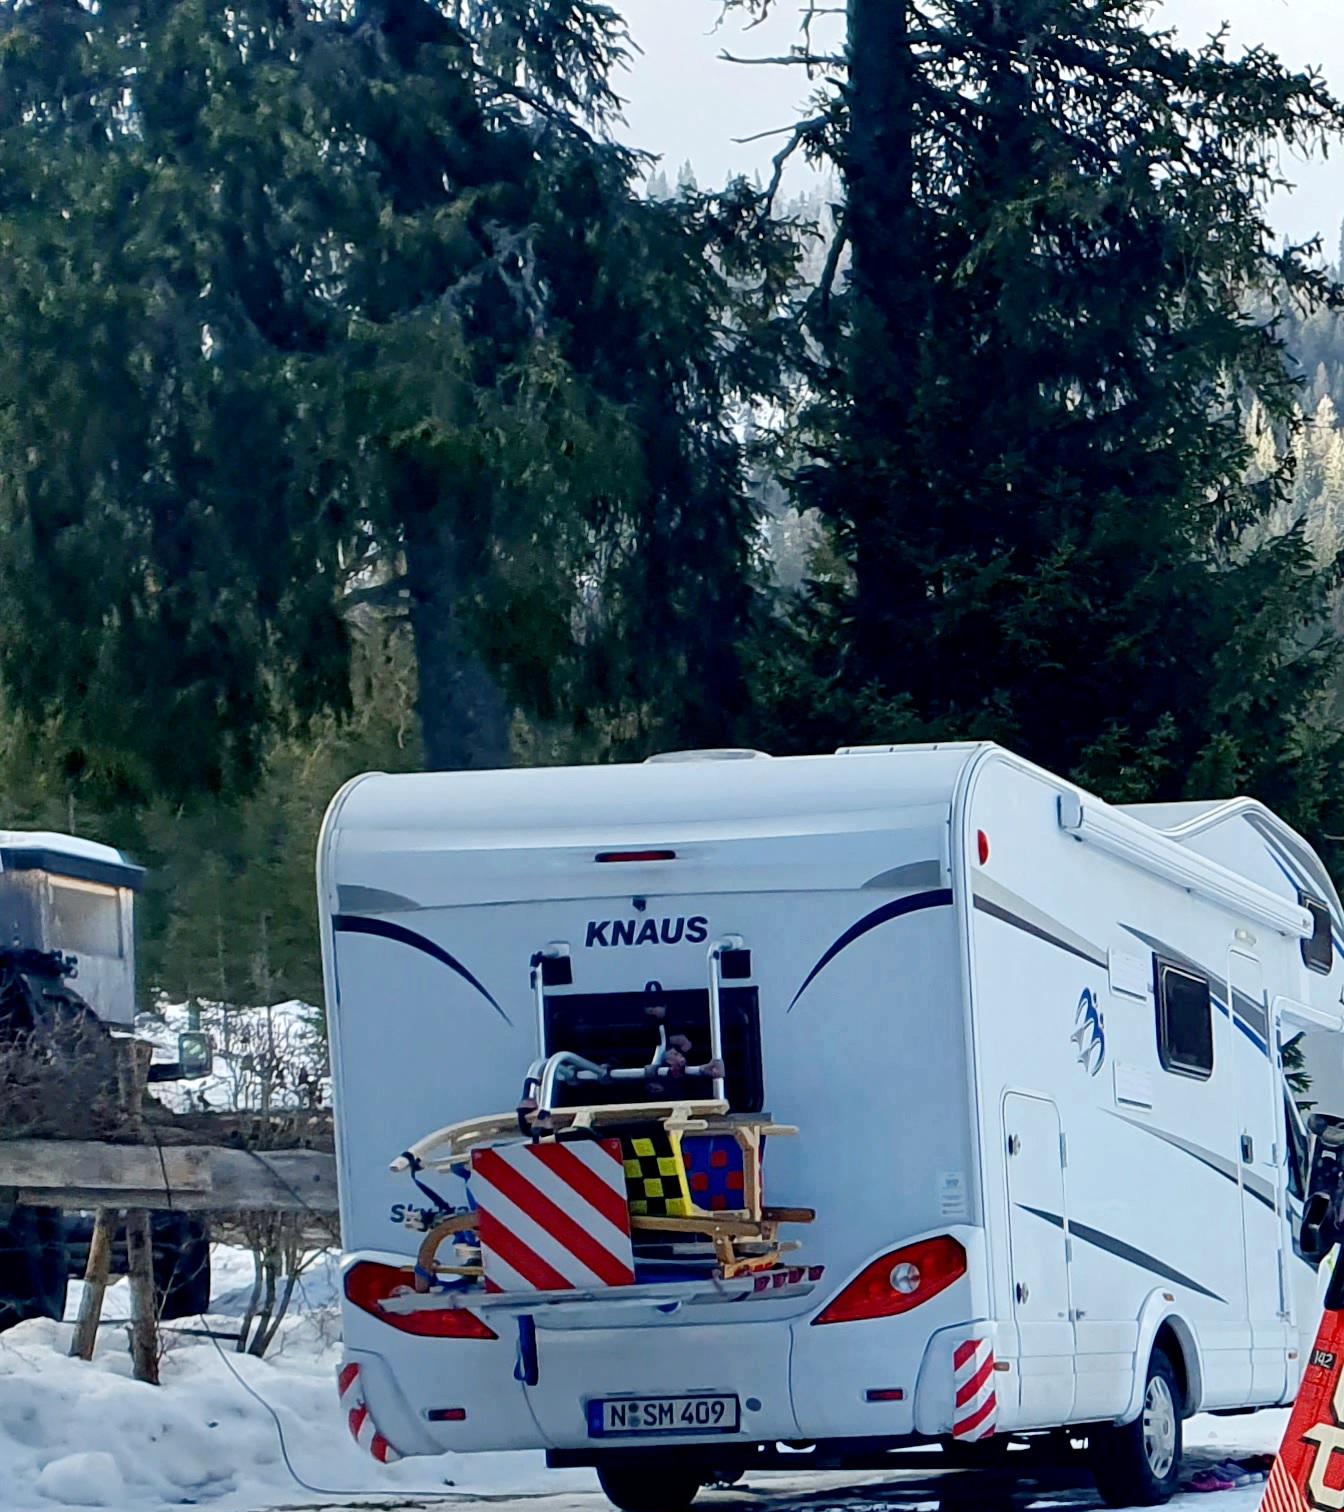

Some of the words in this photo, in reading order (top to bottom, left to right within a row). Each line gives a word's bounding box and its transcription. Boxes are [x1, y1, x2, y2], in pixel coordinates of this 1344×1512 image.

[585, 916, 709, 947] KNAUS
[1313, 1350, 1334, 1369] 142
[610, 1405, 626, 1427] N
[643, 1403, 674, 1426] SM
[681, 1401, 725, 1425] 409
